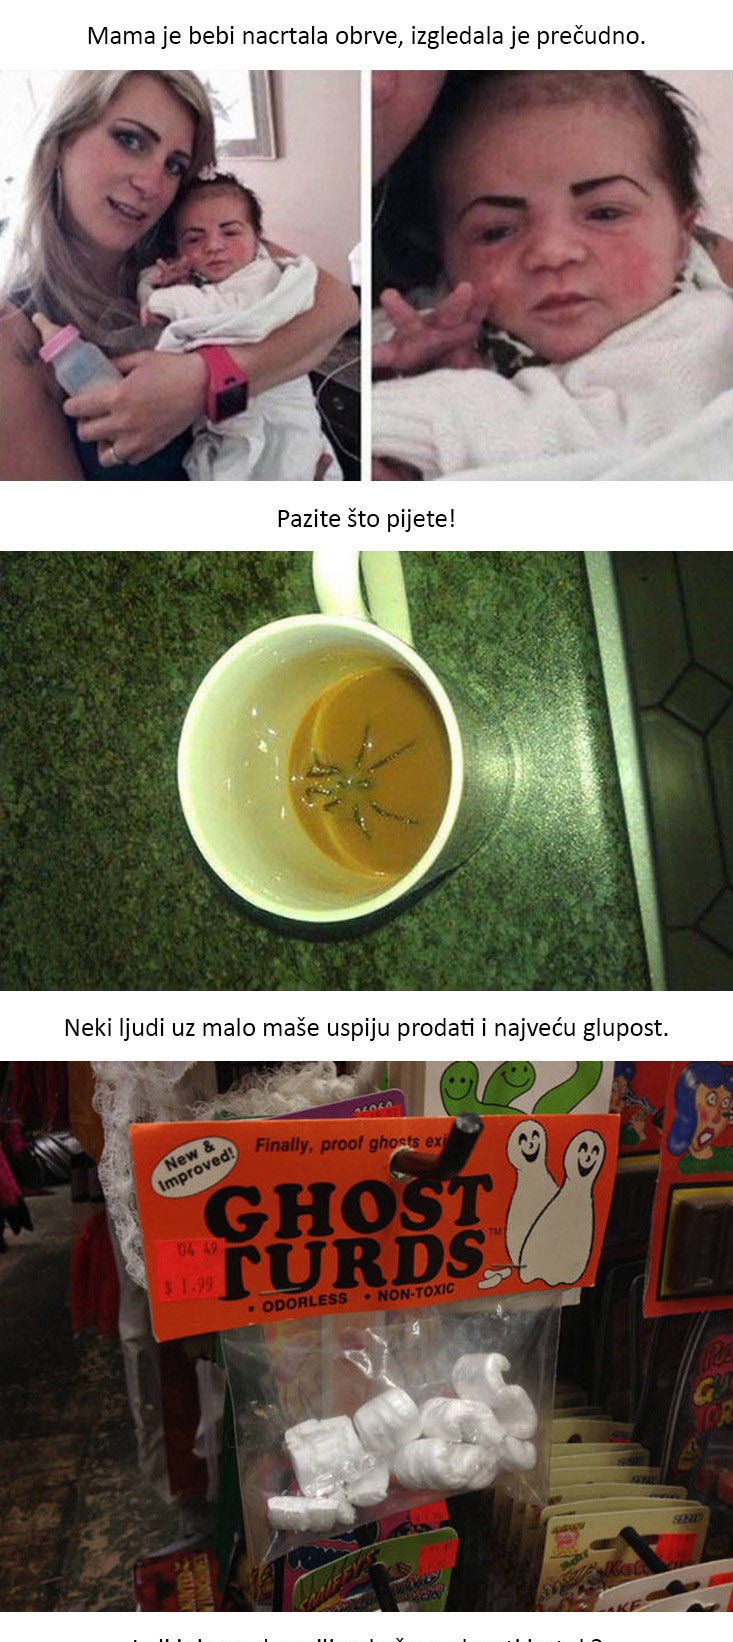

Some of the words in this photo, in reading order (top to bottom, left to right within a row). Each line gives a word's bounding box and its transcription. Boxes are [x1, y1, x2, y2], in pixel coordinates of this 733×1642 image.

[164, 1151, 199, 1172] New
[203, 1139, 216, 1154] &
[255, 1137, 313, 1154] Finally,
[320, 1135, 364, 1154] proof
[369, 1135, 419, 1153] ghosts
[425, 1134, 450, 1149] exi
[158, 1147, 236, 1192] Improved!
[204, 1173, 493, 1243] GHOST
[219, 1229, 486, 1301] TURDS
[262, 1292, 348, 1313] ODORLESS
[377, 1283, 456, 1302] NON-TOXIC
